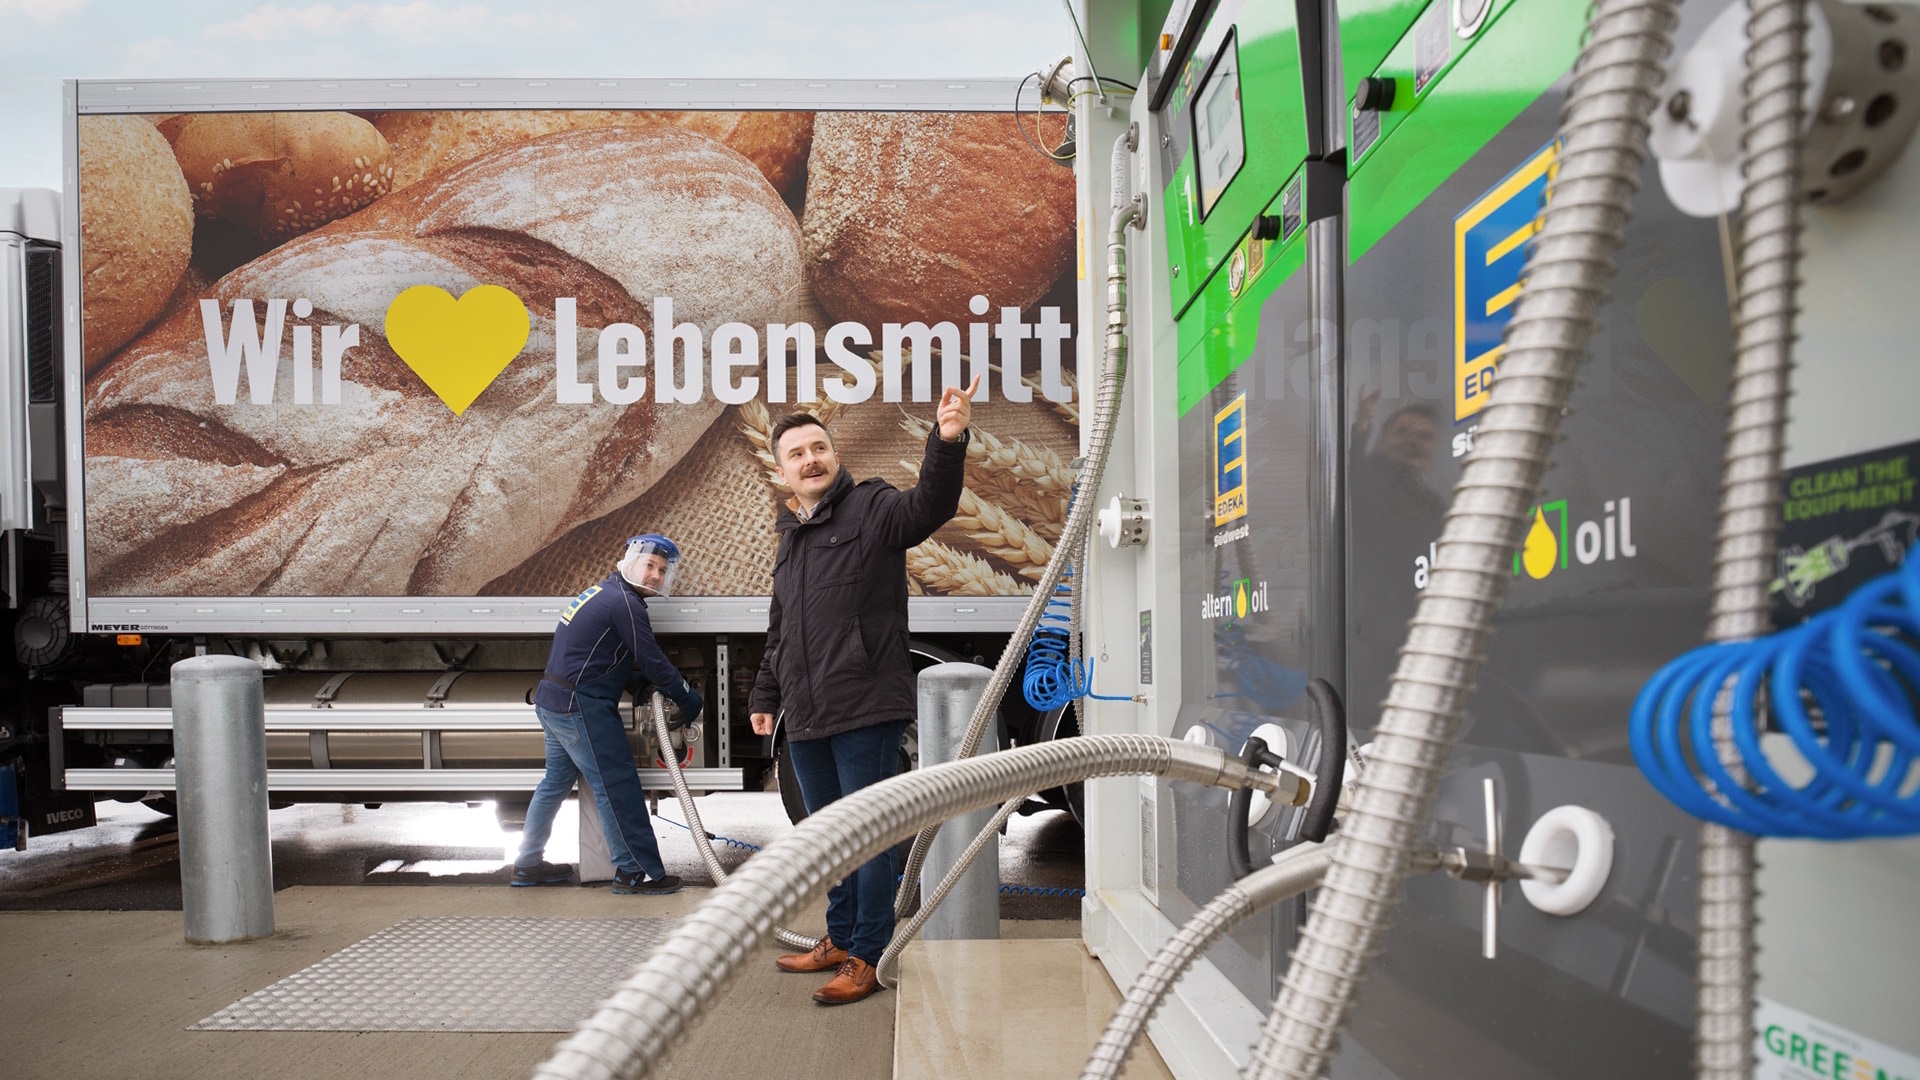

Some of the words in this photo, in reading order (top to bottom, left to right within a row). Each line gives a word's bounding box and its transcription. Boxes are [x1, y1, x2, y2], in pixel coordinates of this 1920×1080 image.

[200, 297, 360, 406] Wir
[555, 294, 1079, 405] Lebensmitt
[1790, 467, 1859, 498] CLEAN
[1863, 456, 1909, 485] THE
[1217, 493, 1245, 517] EDEKA
[1784, 479, 1916, 521] EQUIPMENT
[1574, 496, 1638, 565] oil
[1201, 592, 1233, 620] altern
[1251, 580, 1269, 614] oil
[46, 808, 84, 825] IVECO
